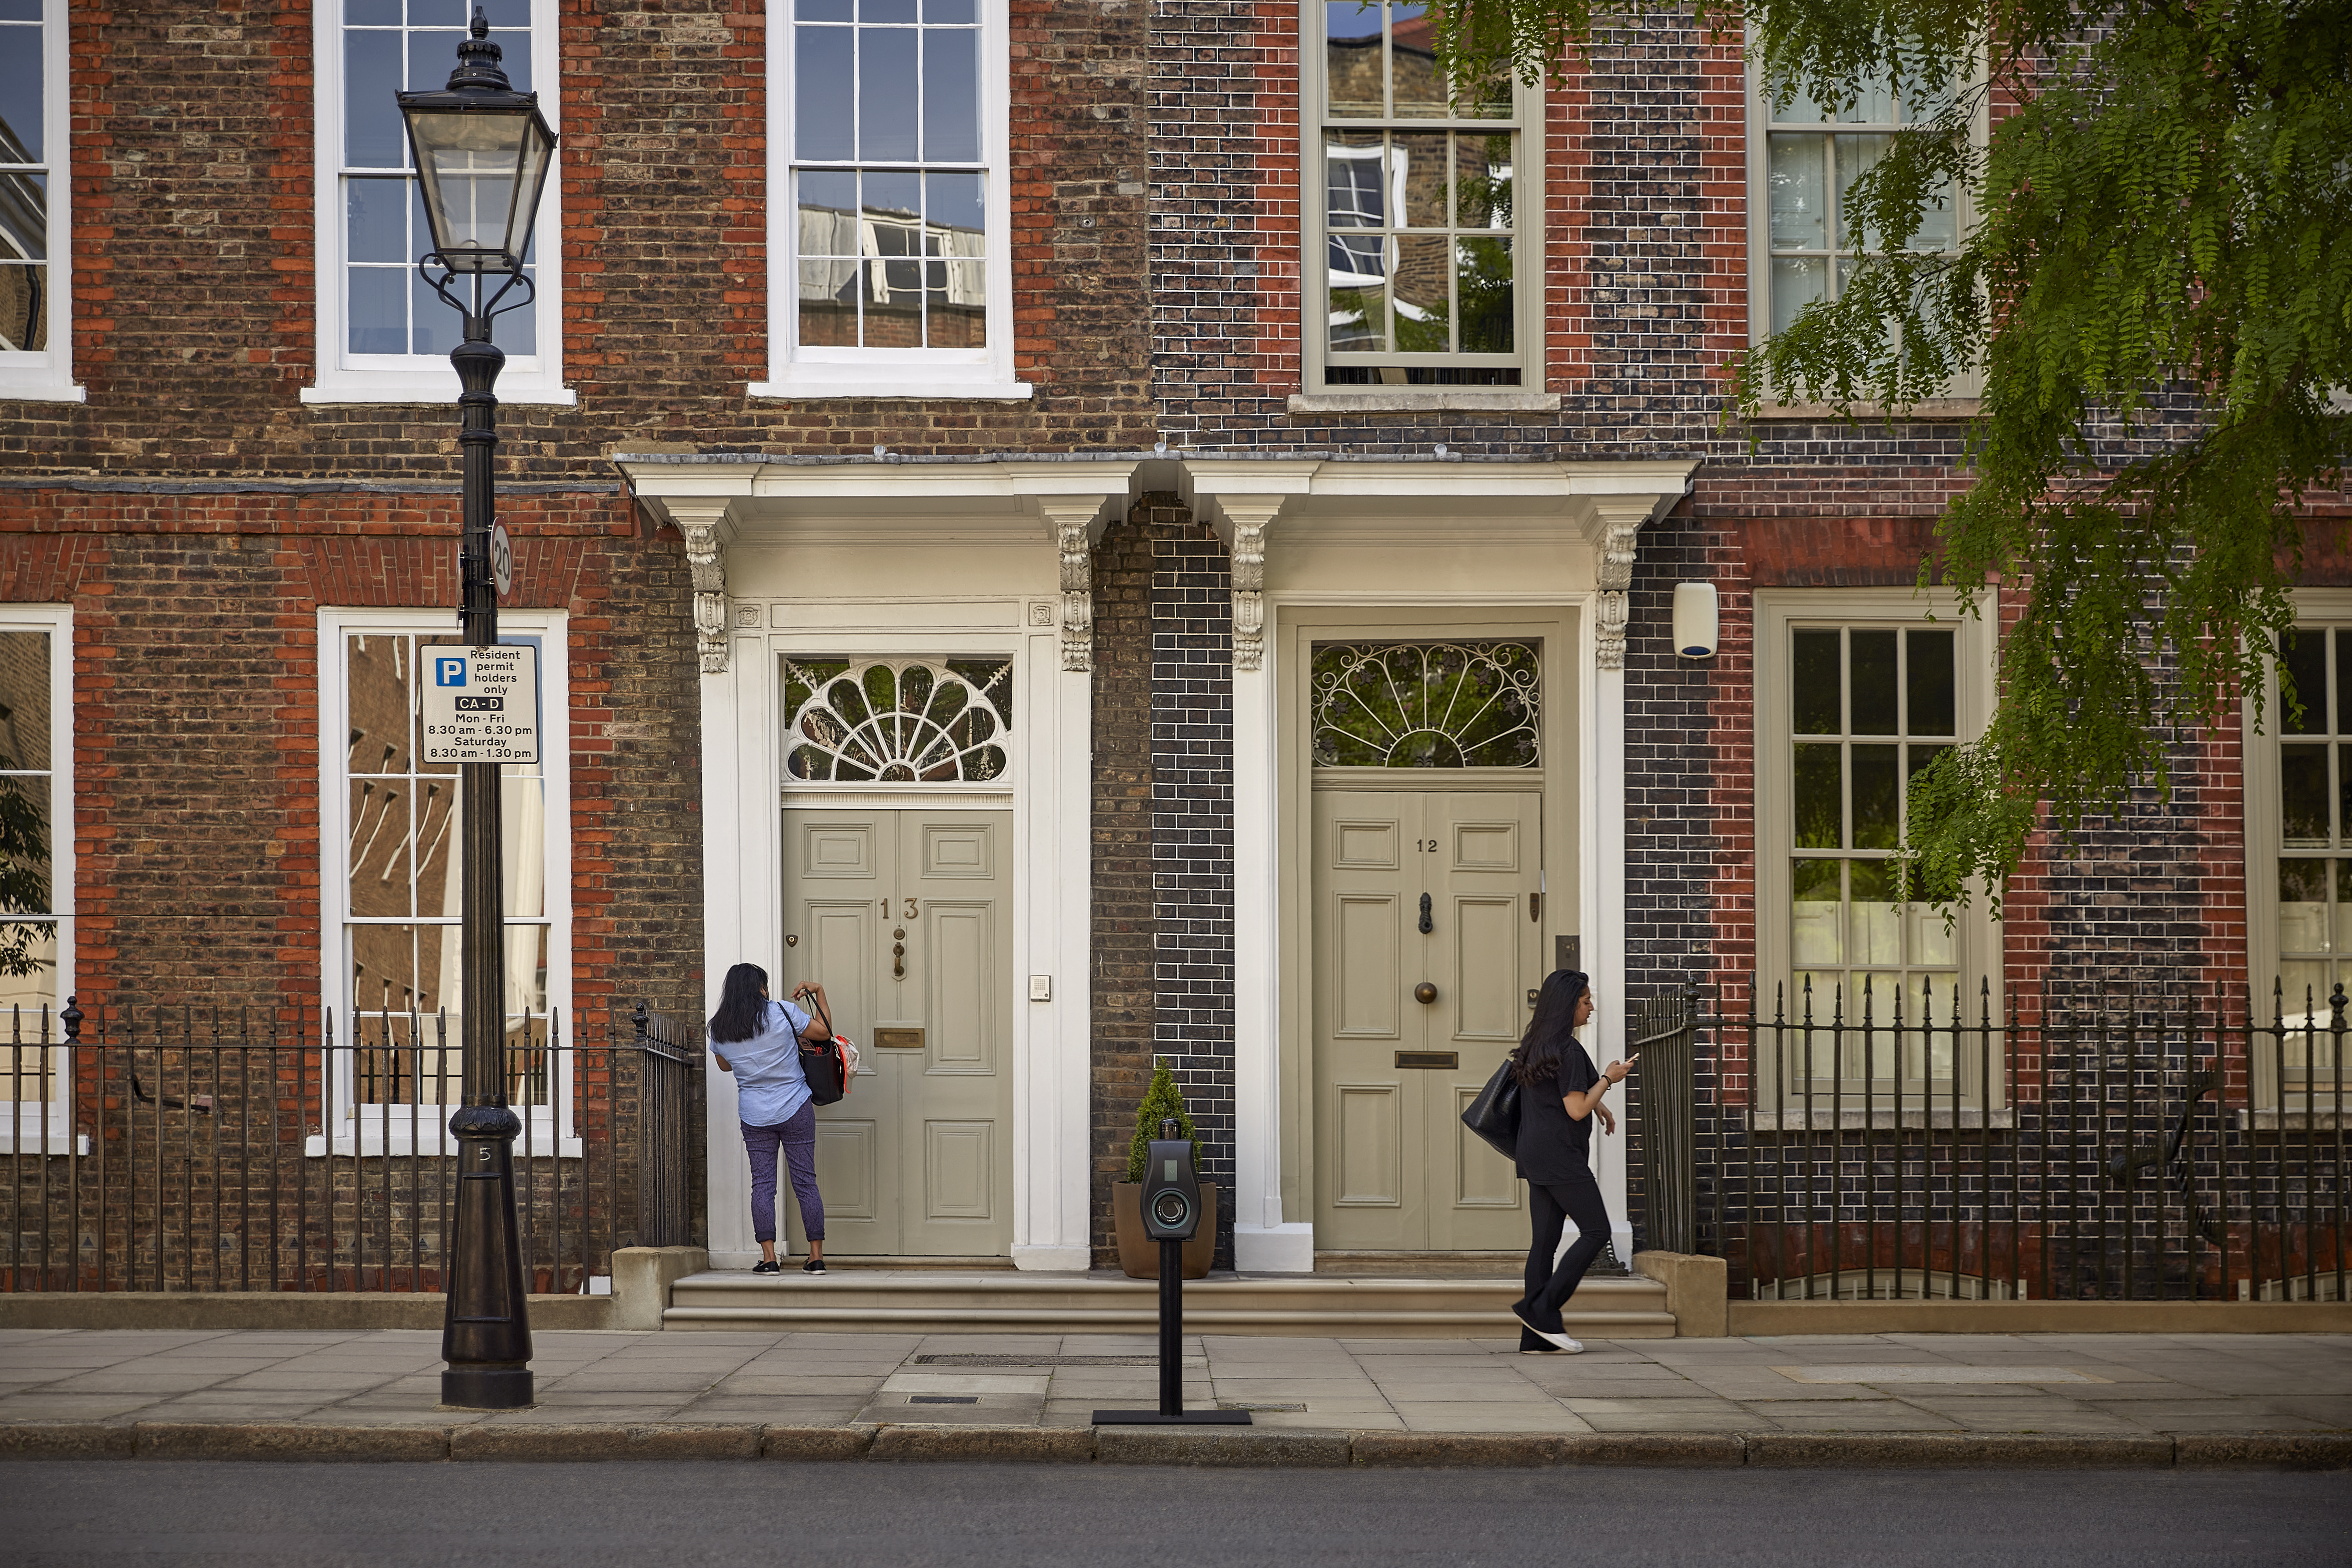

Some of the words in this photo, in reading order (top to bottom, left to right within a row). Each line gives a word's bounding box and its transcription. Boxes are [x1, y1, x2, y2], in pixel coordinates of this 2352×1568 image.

[495, 540, 510, 581] 20
[471, 651, 520, 659] Resident
[444, 661, 462, 684] P
[476, 662, 514, 672] permit
[474, 673, 517, 682] holders
[484, 685, 508, 695] only
[456, 714, 480, 723] Mon
[490, 714, 504, 723] Fri
[429, 725, 456, 734] 8.30
[485, 725, 512, 734] 6.30
[515, 728, 532, 736] pm
[454, 737, 507, 746] Saturday
[430, 748, 458, 757] 8.30
[487, 748, 511, 758] 1.30
[514, 751, 531, 759] pm
[1417, 839, 1437, 852] 12
[880, 898, 919, 920] 13
[480, 1147, 490, 1160] 5
